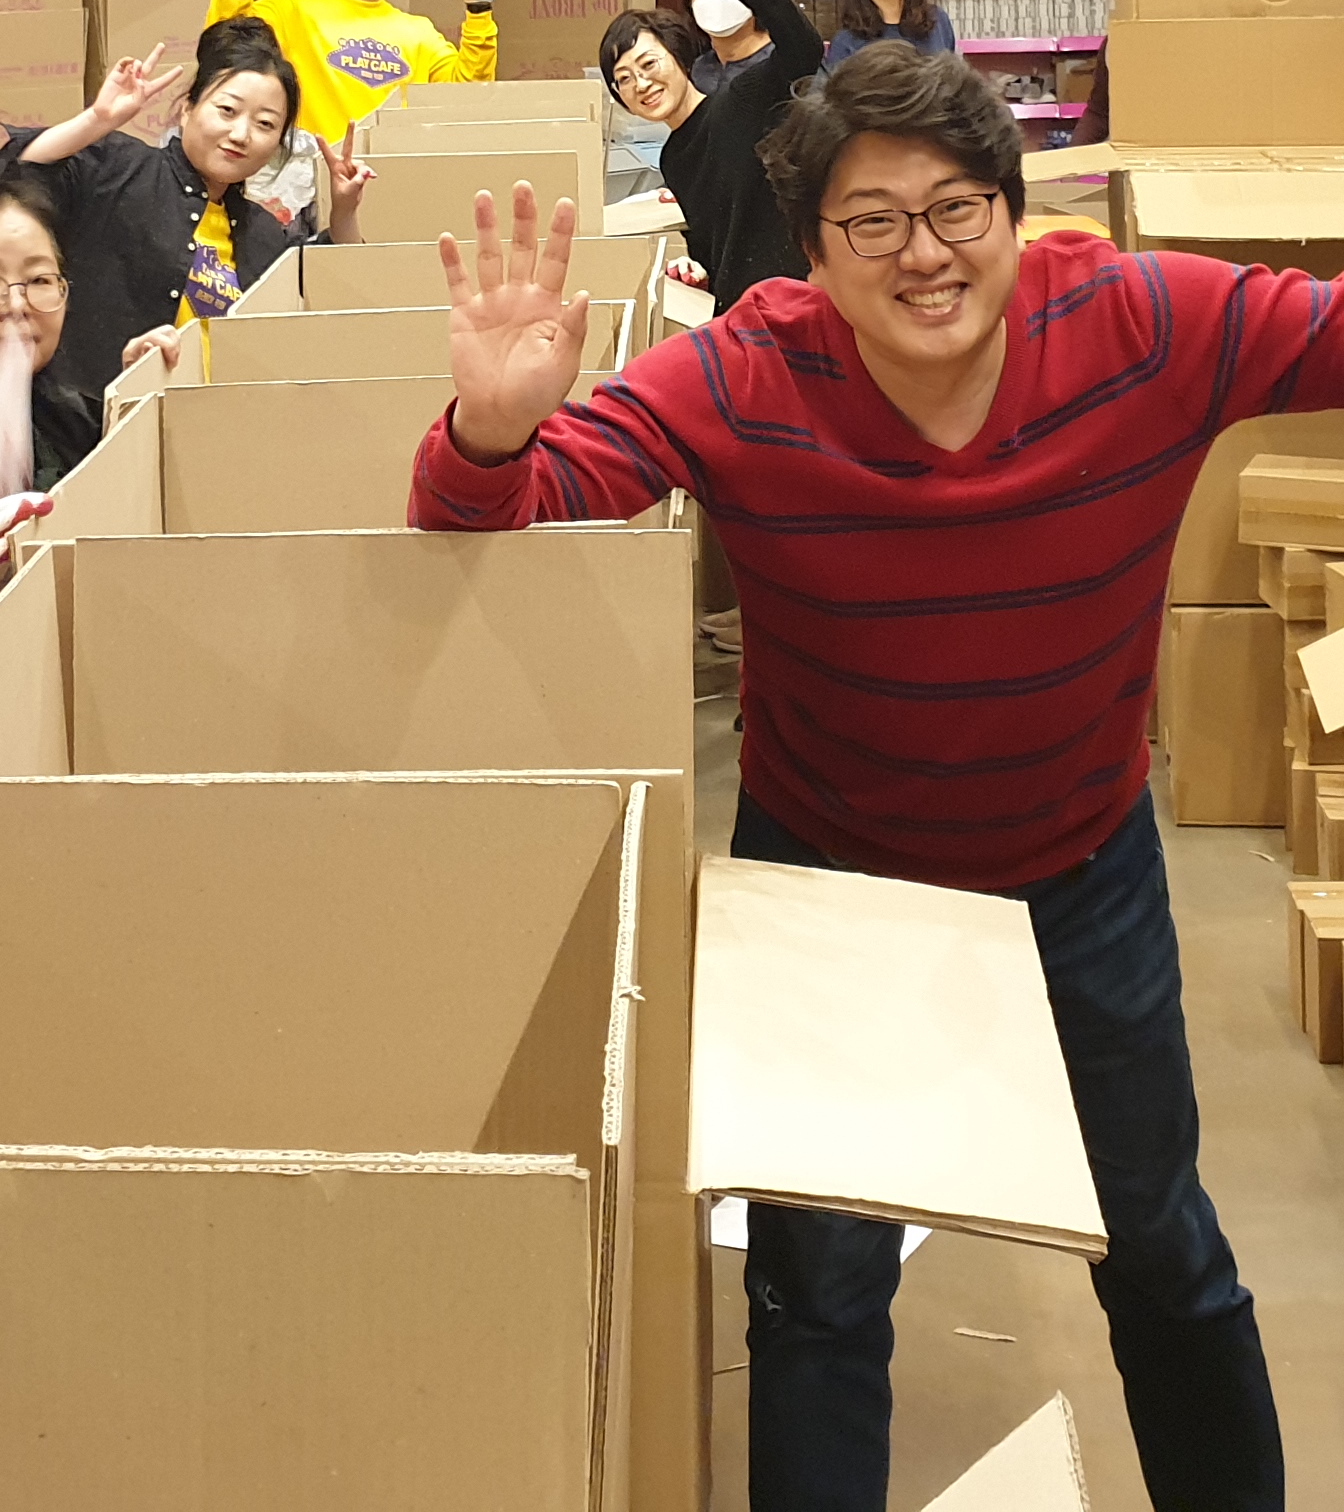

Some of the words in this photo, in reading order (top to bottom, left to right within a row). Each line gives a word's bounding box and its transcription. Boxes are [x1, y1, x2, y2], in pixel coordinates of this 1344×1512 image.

[340, 55, 370, 70] PLAY
[370, 60, 401, 75] CAFE
[188, 267, 214, 289] LAY
